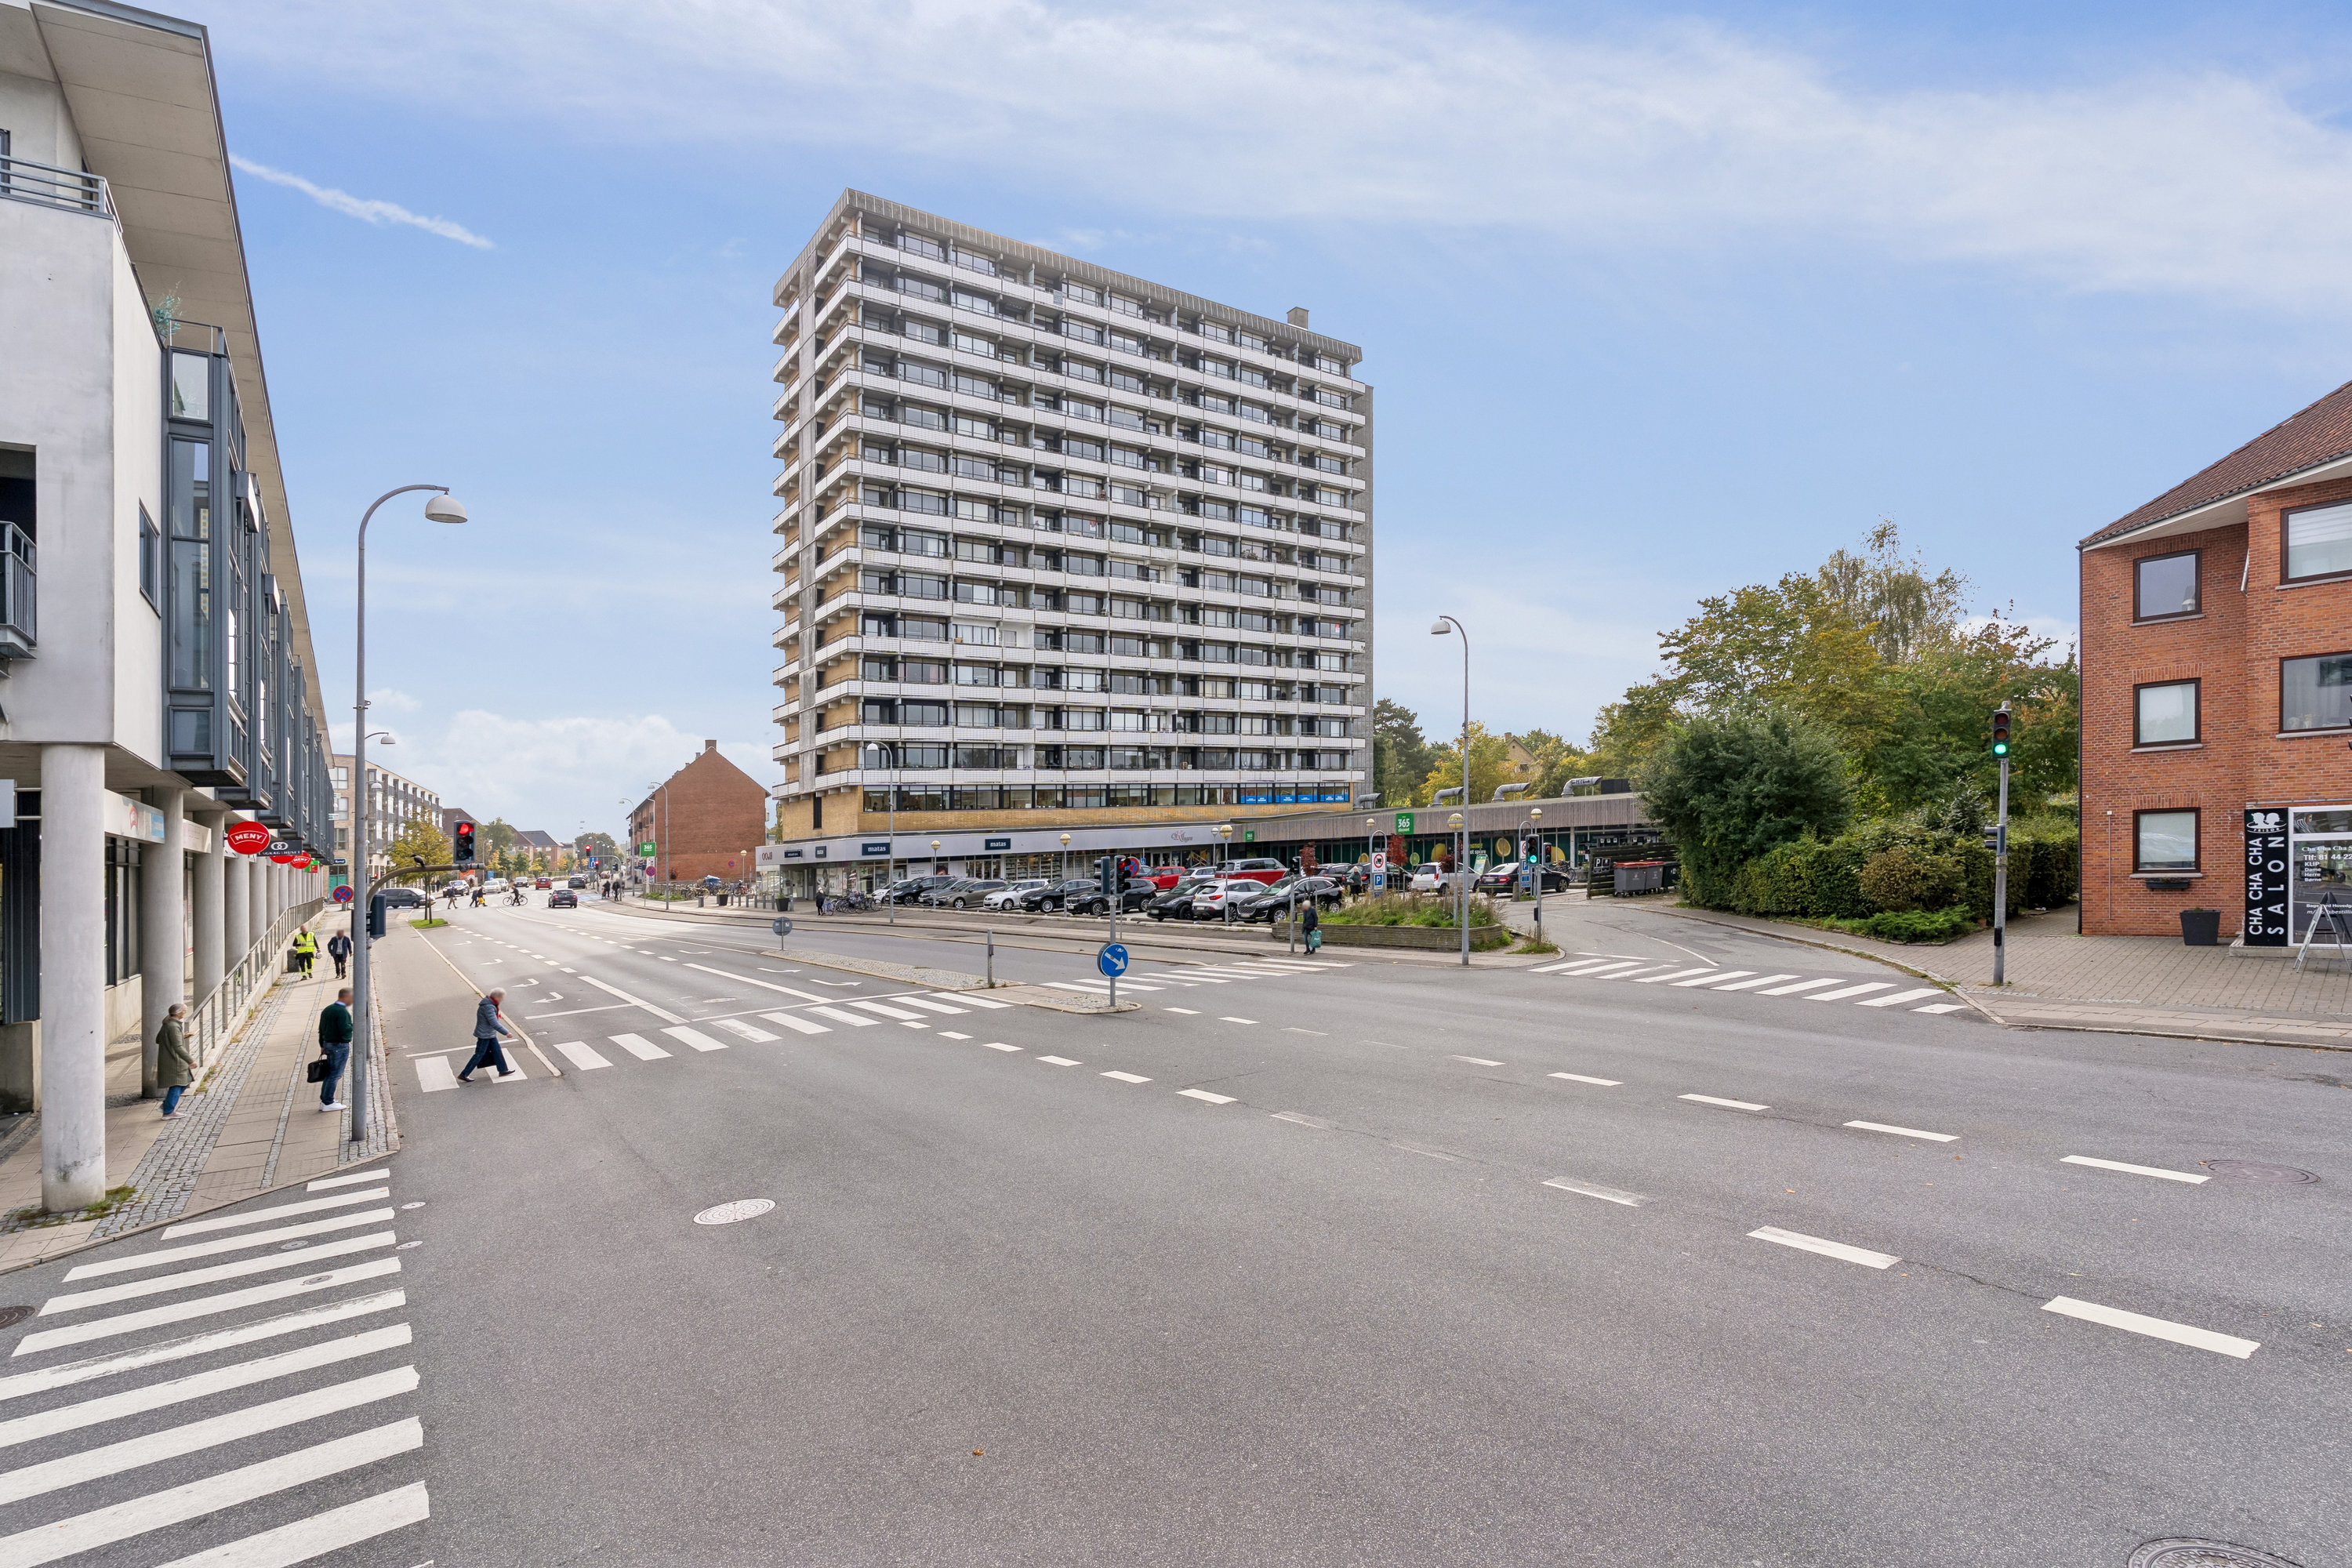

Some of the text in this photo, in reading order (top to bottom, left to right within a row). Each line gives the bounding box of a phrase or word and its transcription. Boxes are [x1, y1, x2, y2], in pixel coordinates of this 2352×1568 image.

[1398, 818, 1410, 828] 365
[234, 833, 263, 841] MENY
[1376, 876, 1381, 884] P
[2249, 837, 2263, 935] CHA CHA CHA
[2267, 837, 2285, 935] SALON
